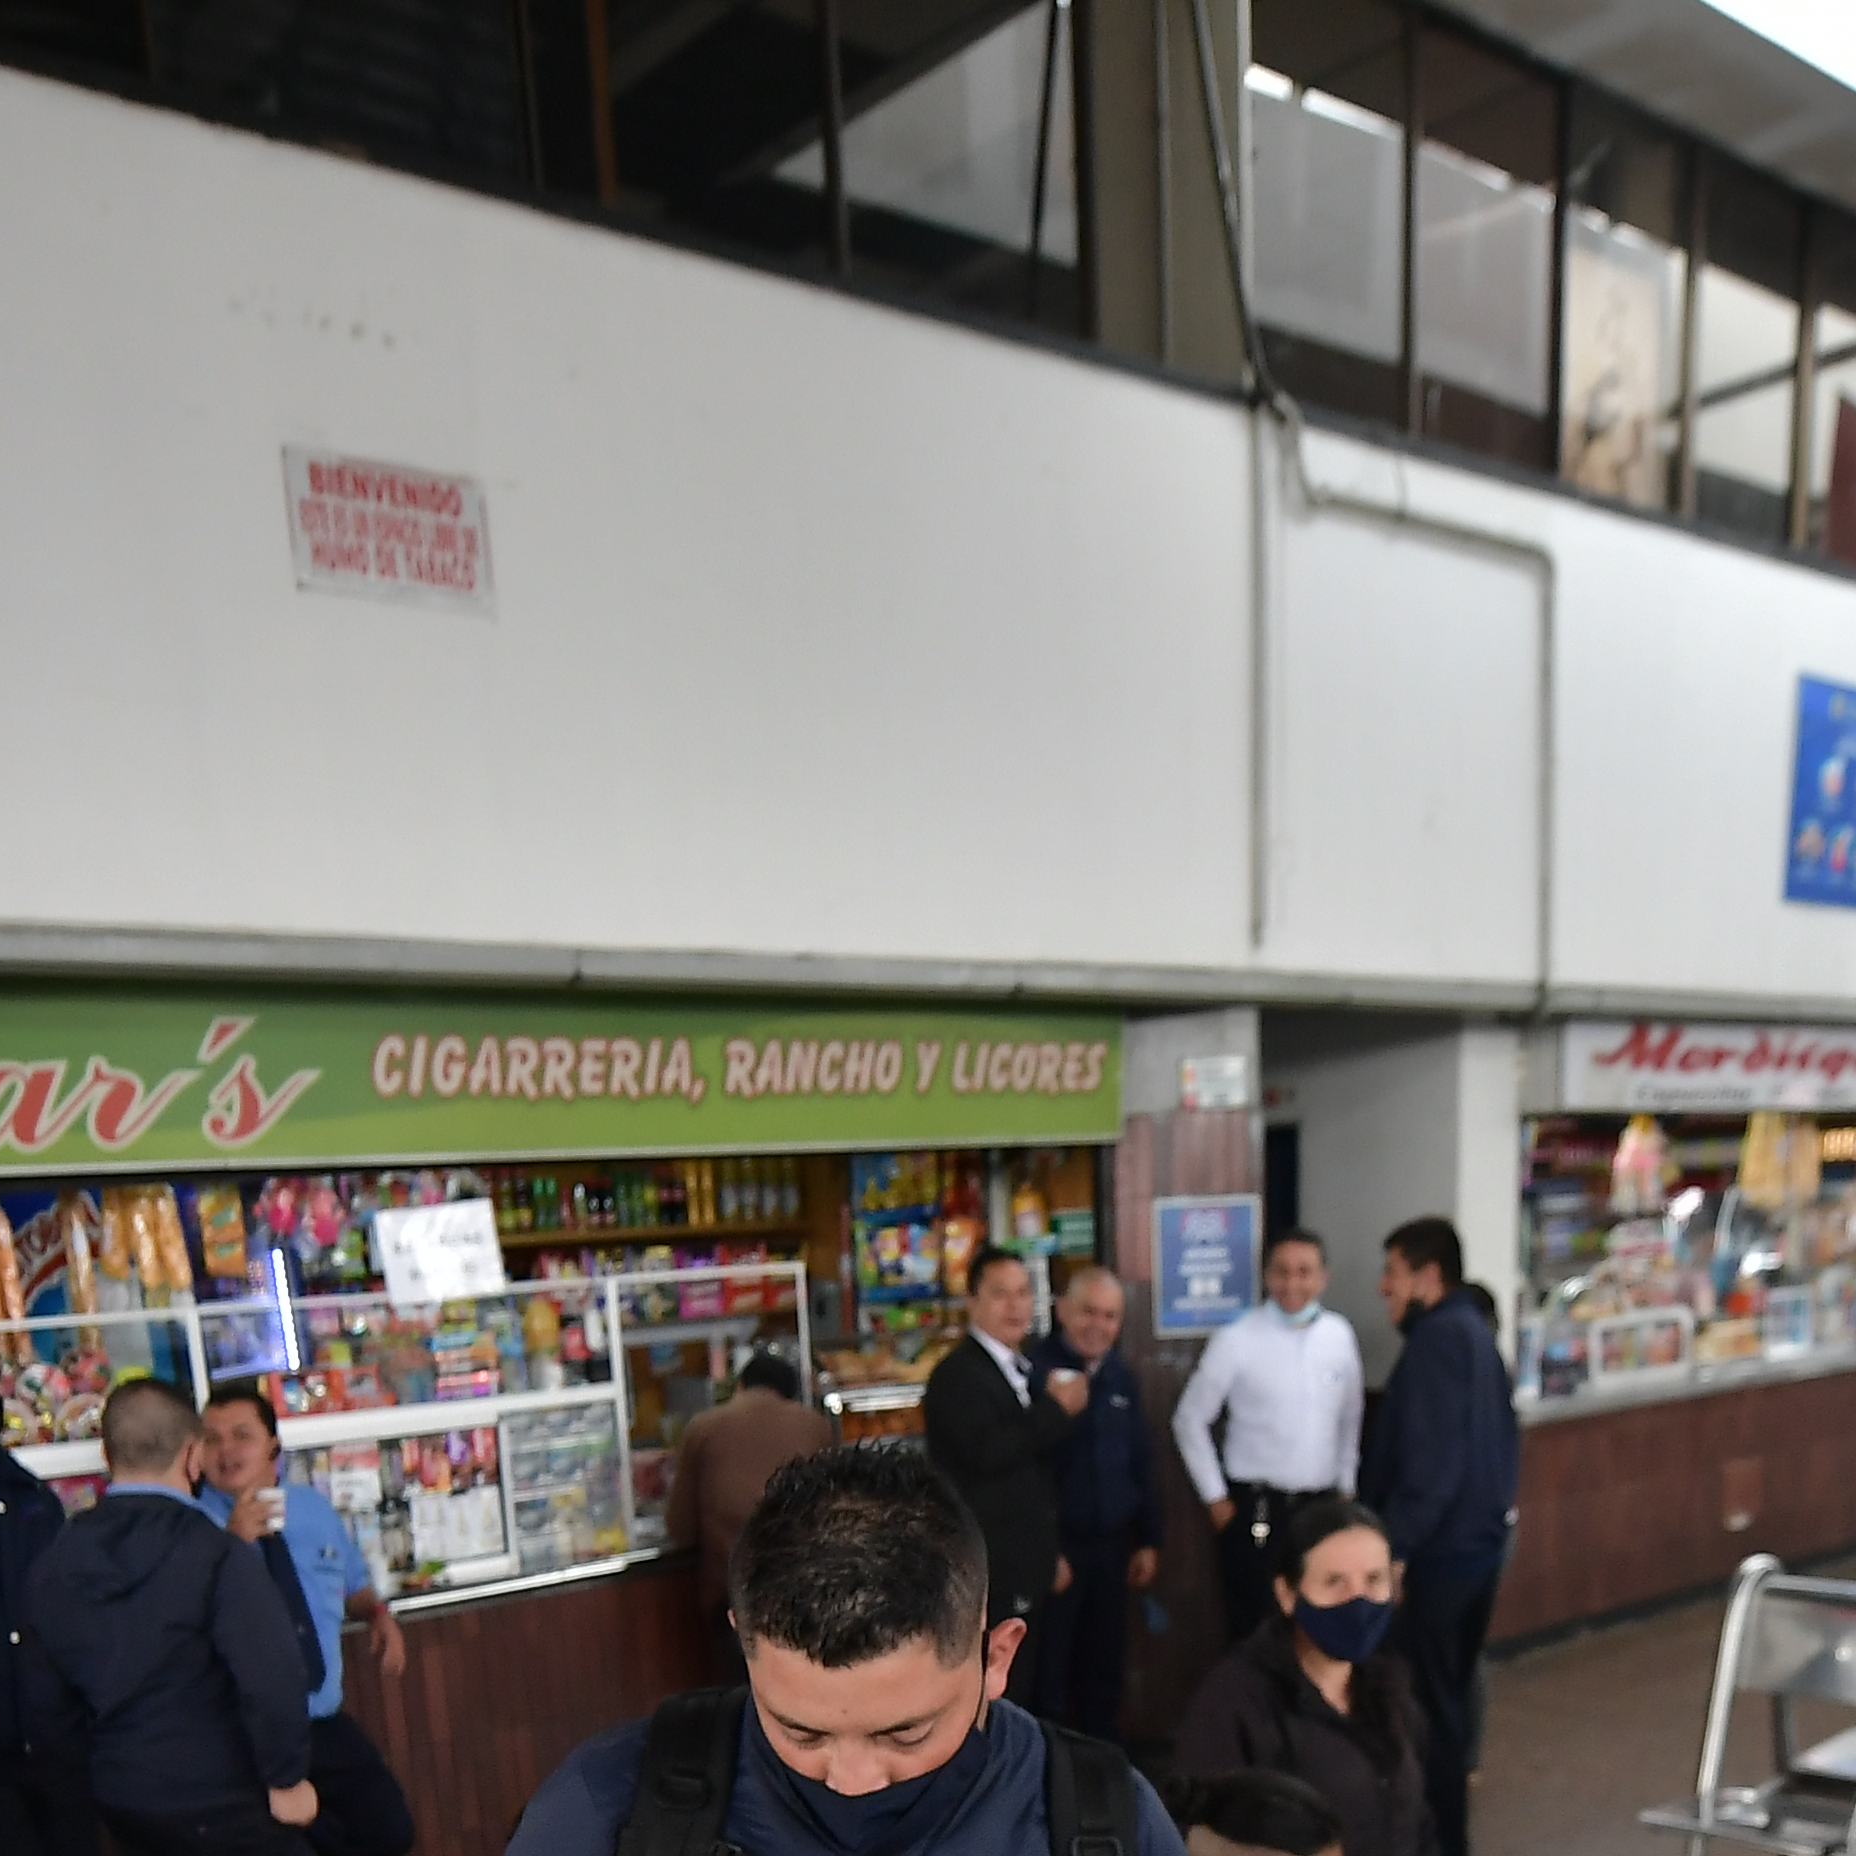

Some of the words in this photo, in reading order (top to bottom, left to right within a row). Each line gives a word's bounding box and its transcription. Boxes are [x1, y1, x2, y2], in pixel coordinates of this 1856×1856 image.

[309, 460, 463, 517] BIENVENIDO
[371, 1032, 707, 1105] CIGARRERIA,
[723, 1036, 905, 1100] RANCHO
[915, 1038, 943, 1096] Y
[950, 1039, 1109, 1097] LICORES
